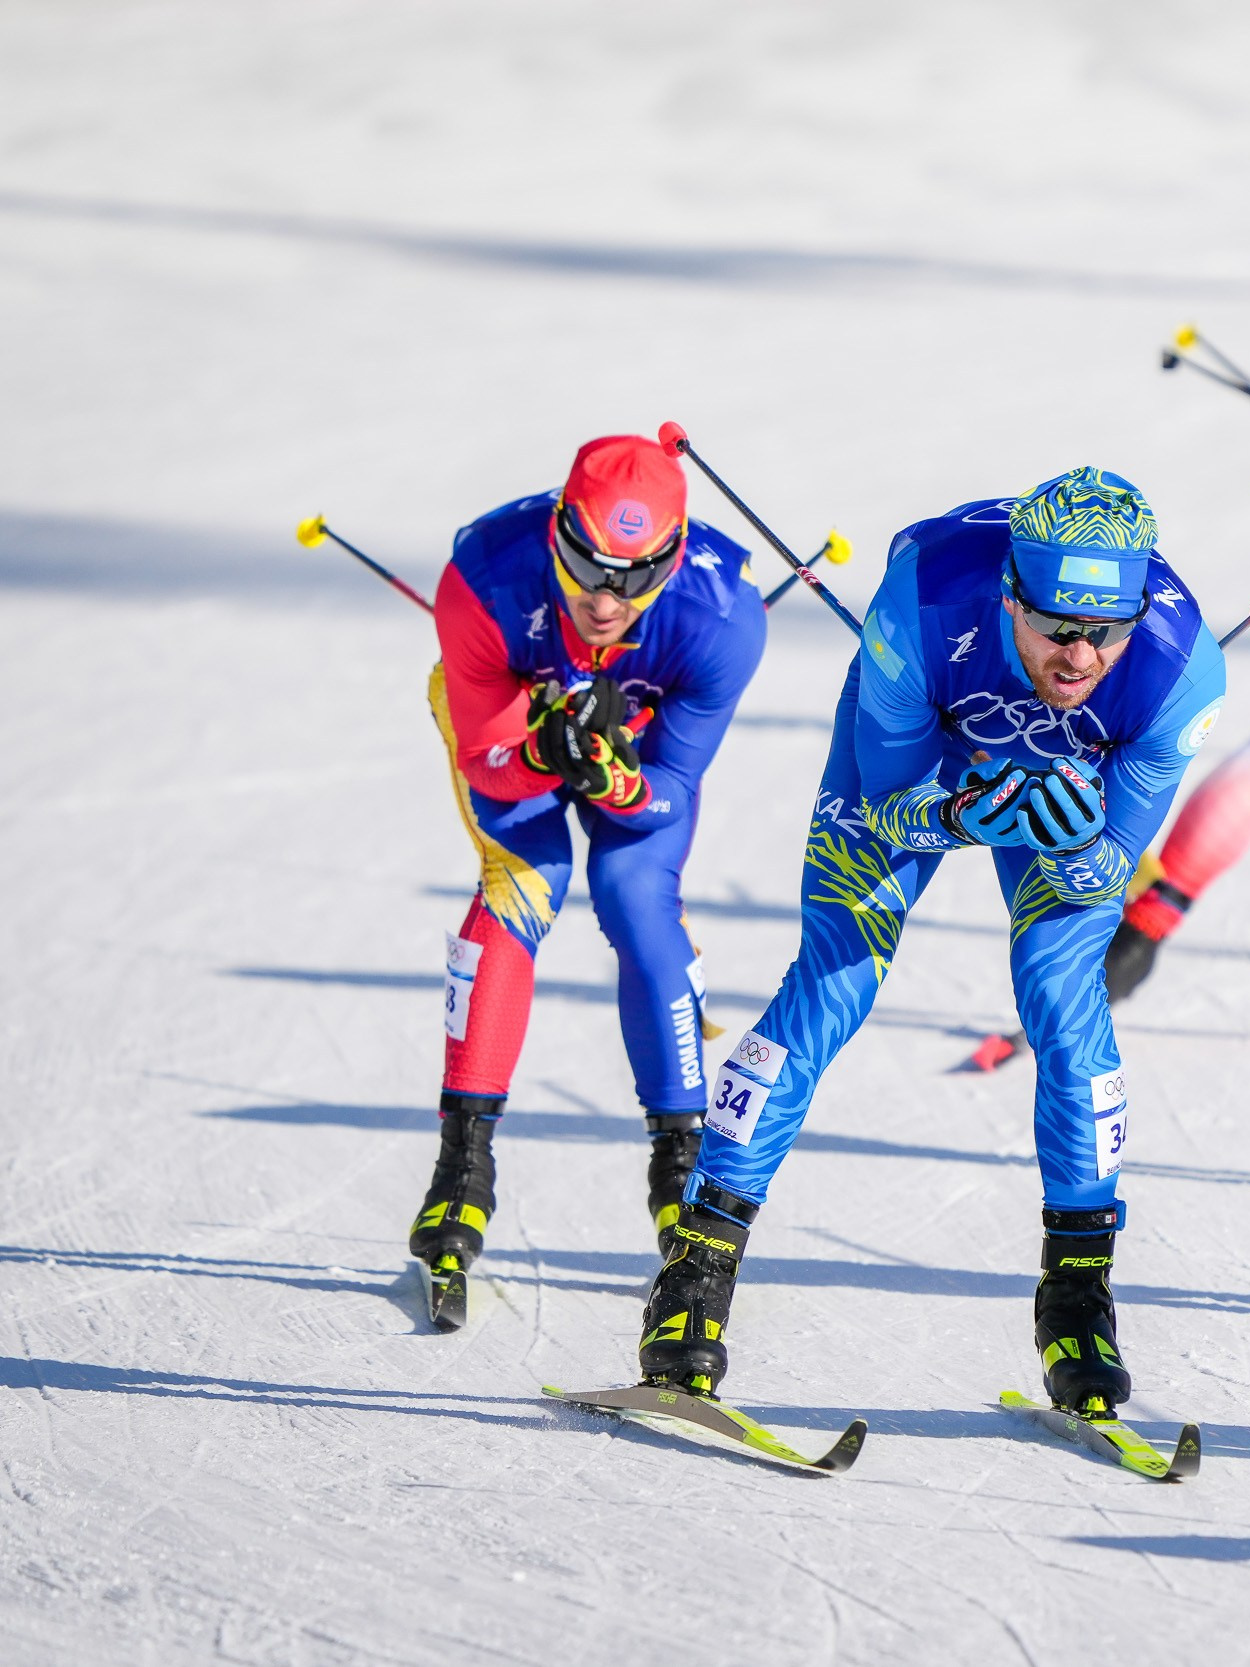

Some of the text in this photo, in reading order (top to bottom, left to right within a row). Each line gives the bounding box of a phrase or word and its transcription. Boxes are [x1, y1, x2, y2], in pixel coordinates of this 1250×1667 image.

[1055, 589, 1119, 608] KAZ
[991, 778, 1019, 808] KV+
[1057, 765, 1091, 791] KV+
[816, 787, 870, 840] KAZ
[1065, 858, 1103, 892] KAZ
[670, 992, 703, 1091] ROMANIA
[715, 1079, 753, 1121] 34
[720, 1126, 738, 1140] 2022
[1059, 1255, 1115, 1268] FISCH
